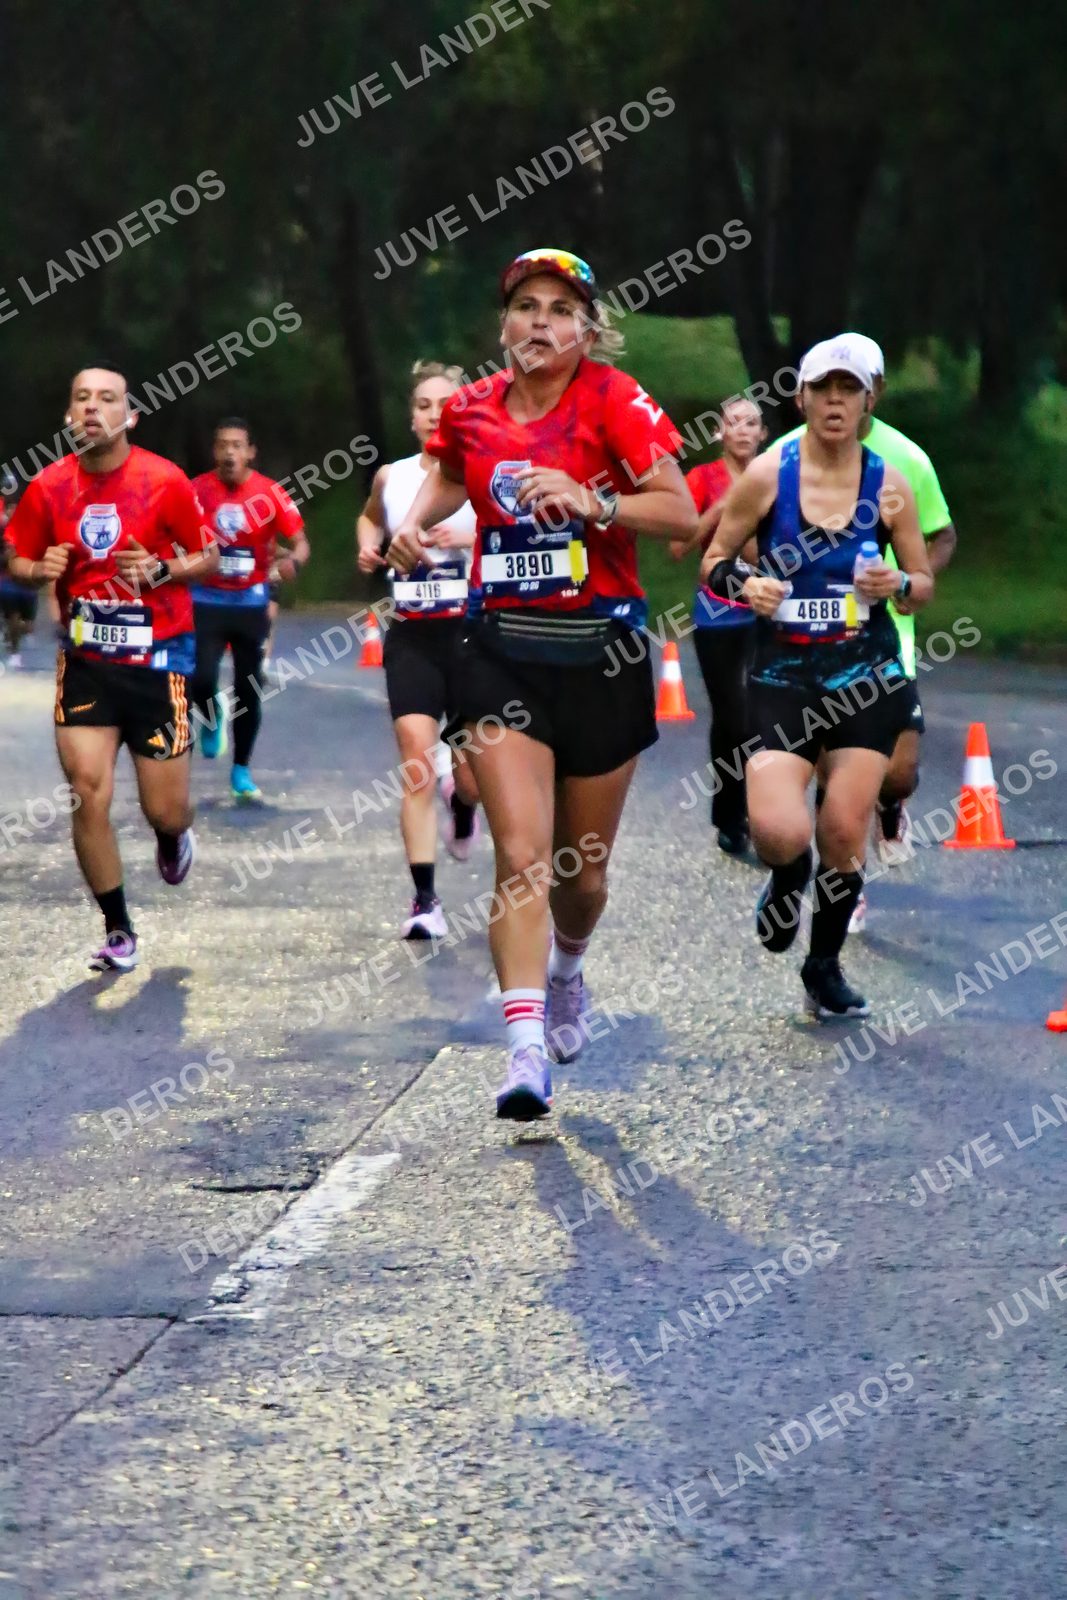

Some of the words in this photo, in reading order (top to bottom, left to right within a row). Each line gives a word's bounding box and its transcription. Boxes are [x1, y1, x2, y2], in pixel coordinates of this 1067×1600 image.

[505, 553, 553, 578] 3890
[797, 601, 840, 619] 4688
[92, 625, 128, 643] 4863
